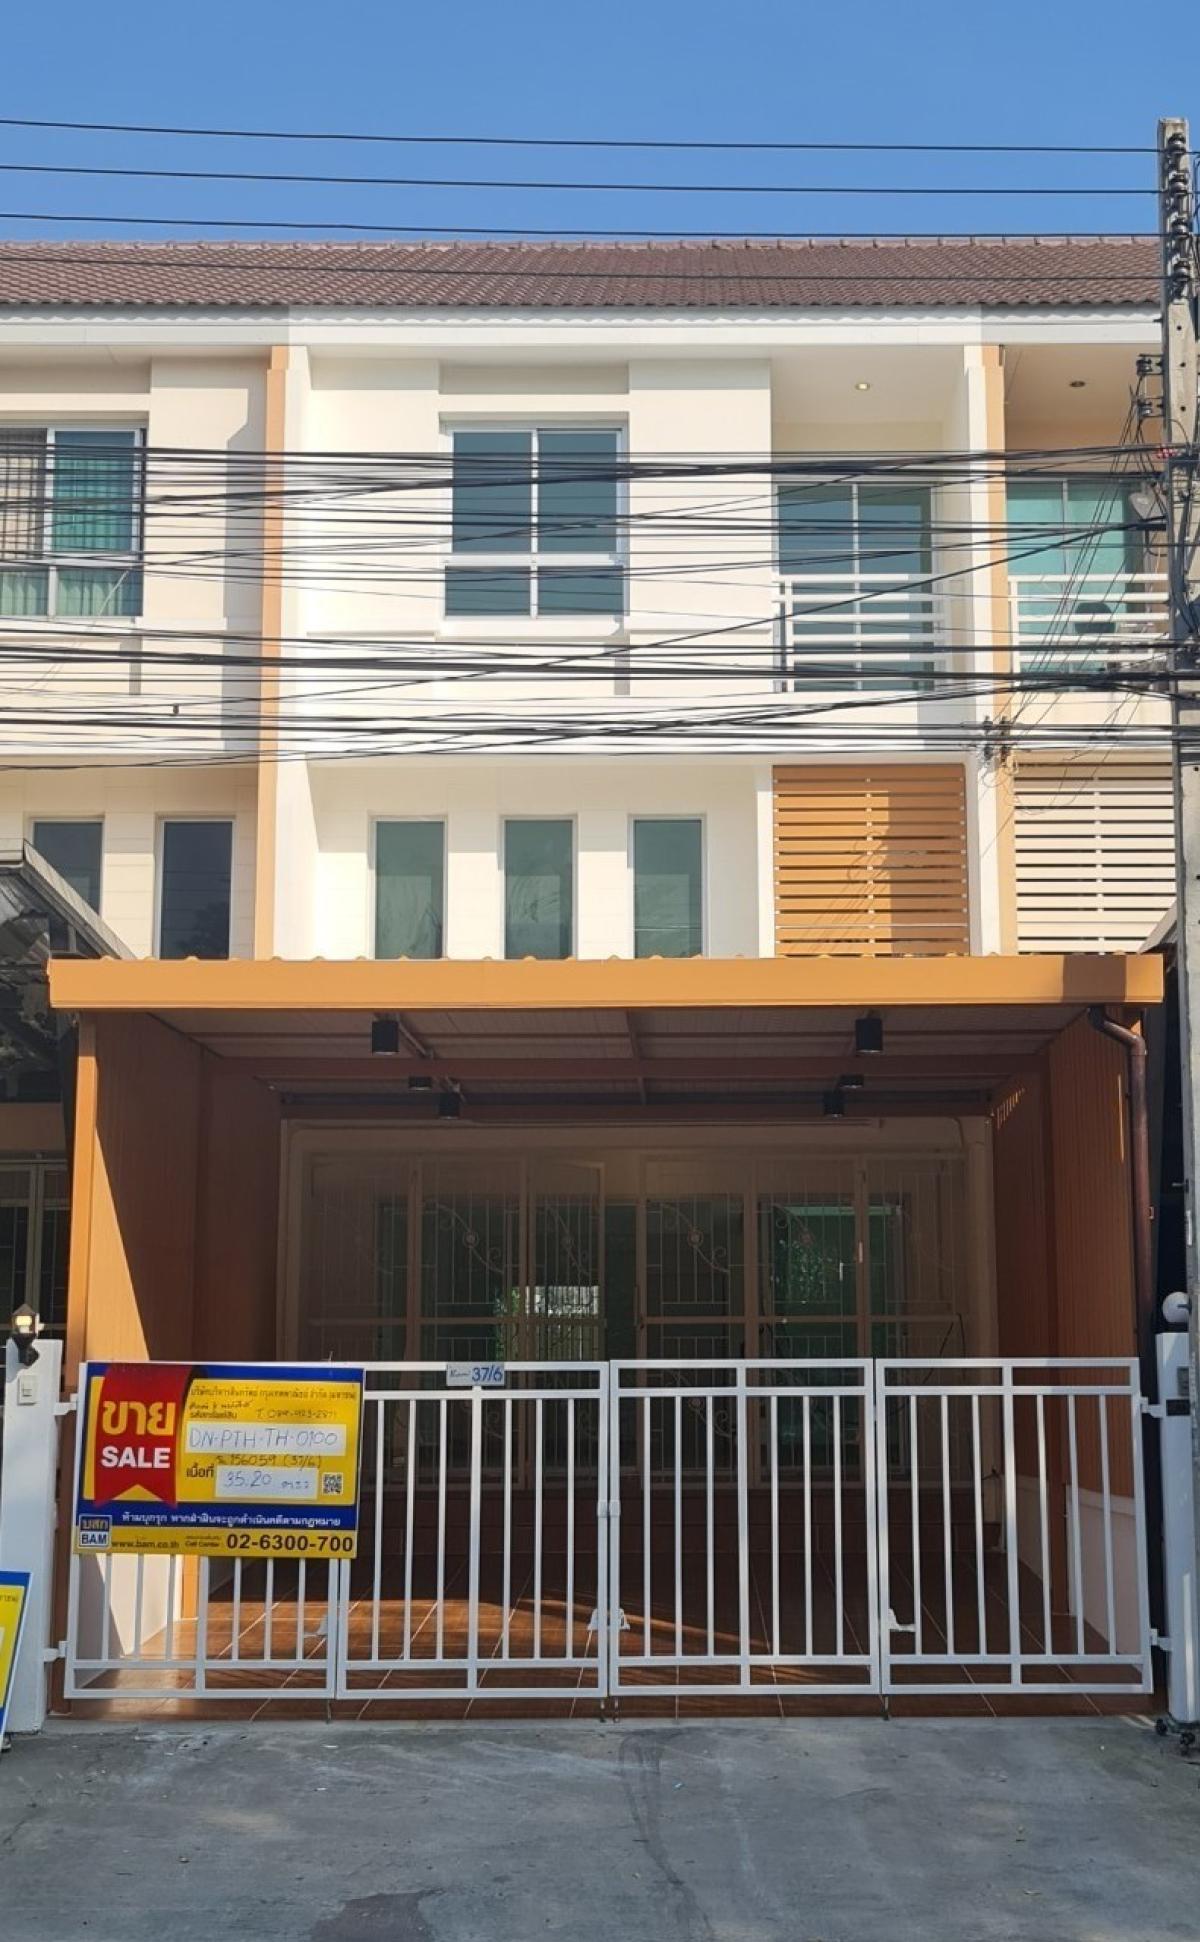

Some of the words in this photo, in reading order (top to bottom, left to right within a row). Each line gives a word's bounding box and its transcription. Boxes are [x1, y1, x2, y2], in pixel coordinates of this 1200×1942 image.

[472, 1364, 503, 1382] 37/6
[102, 1401, 176, 1436] ขาย
[101, 1446, 171, 1469] SALE
[81, 1533, 108, 1545] BAM
[226, 1533, 353, 1552] 02-6300-700
